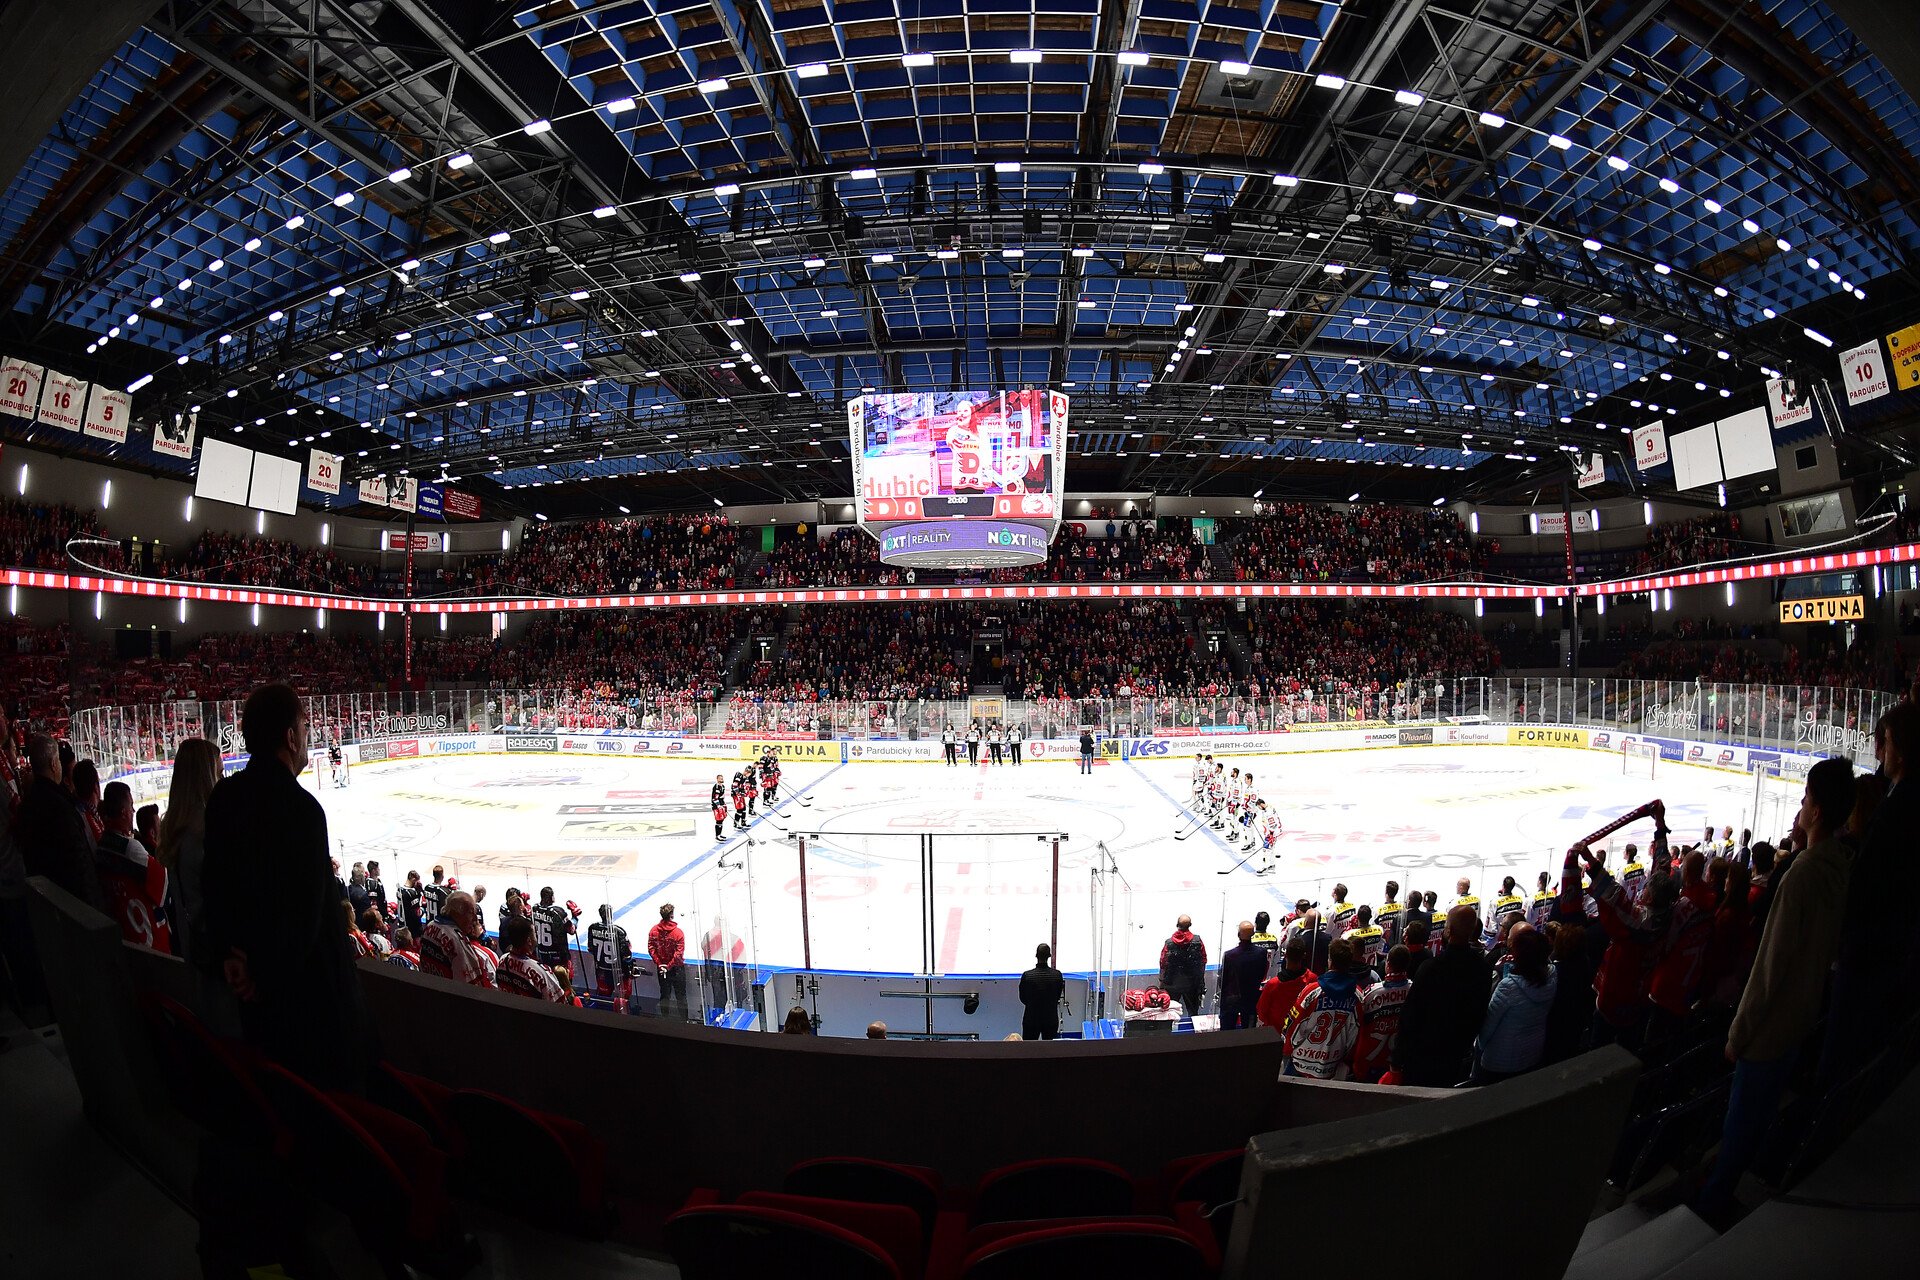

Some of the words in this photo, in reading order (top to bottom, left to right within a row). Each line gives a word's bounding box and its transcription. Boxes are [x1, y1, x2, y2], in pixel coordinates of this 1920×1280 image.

[1856, 362, 1873, 382] 10
[8, 377, 27, 397] 20
[1849, 380, 1887, 399] PARDUBICE
[0, 398, 33, 413] ARDUBICE
[54, 391, 71, 409] 16
[40, 409, 79, 426] PARDUBICE
[103, 405, 114, 421] 5
[1774, 406, 1810, 423] PARDUBICE
[86, 422, 125, 437] PARDUBICE
[155, 439, 190, 453] PARDUBICE
[1646, 439, 1653, 452] 9
[1638, 452, 1666, 466] PARDUBICE
[318, 464, 332, 479] 20
[1579, 473, 1604, 484] PARDUBICE
[309, 478, 338, 490] PARDUBICE
[360, 491, 385, 502] PARDUBICE
[904, 501, 916, 515] 0
[999, 500, 1011, 514] 0
[912, 534, 951, 544] REALITY
[1782, 600, 1861, 619] FORTUNA
[390, 714, 447, 733] IMPULS
[507, 738, 556, 750] RADEGAST
[1518, 731, 1579, 743] FORTUNA
[1816, 724, 1867, 753] IMPULS
[438, 740, 477, 752] Tipsport
[866, 746, 913, 757] Pardubický
[915, 746, 931, 757] kraj
[1048, 744, 1080, 753] Pardubic
[1383, 851, 1531, 869] GOLF
[592, 938, 617, 964] 79
[1308, 1012, 1349, 1046] 37
[1296, 1048, 1330, 1061] SÝKORA
